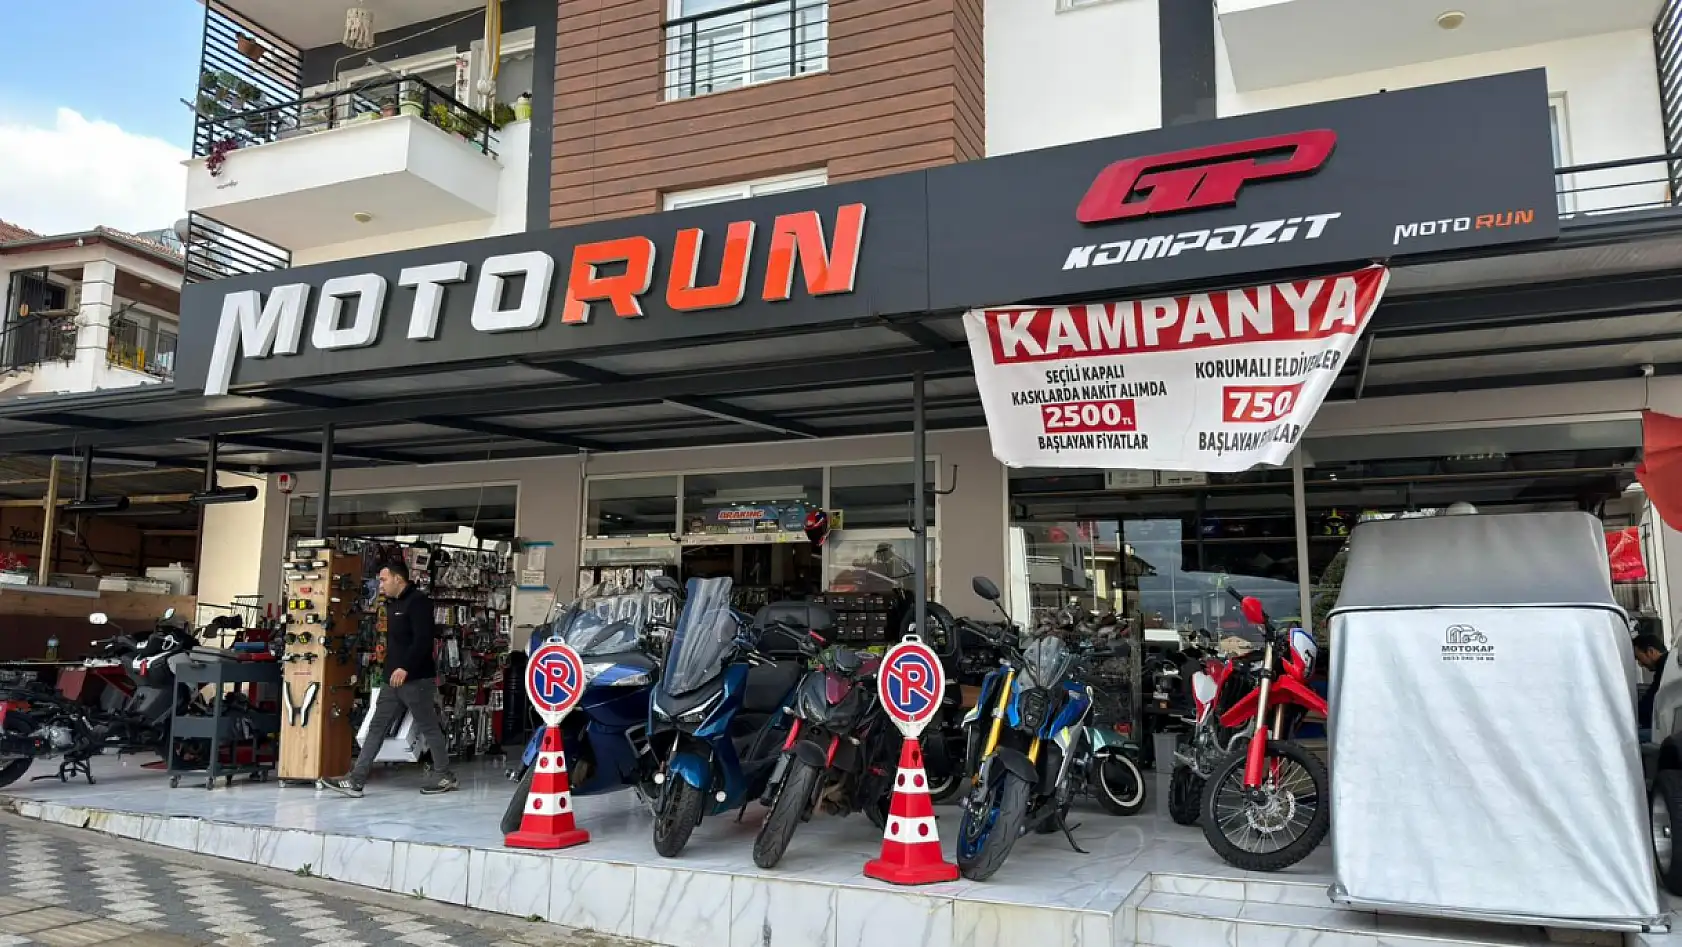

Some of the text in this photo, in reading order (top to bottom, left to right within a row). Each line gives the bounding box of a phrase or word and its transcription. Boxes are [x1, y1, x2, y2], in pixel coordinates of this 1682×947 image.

[996, 276, 1358, 358] KAMPANYA
[1045, 363, 1125, 386] SEÇİLİ KAPALI
[1195, 358, 1271, 379] KORUMALI
[1011, 381, 1168, 406] KASKLARDA NAKİT ALIMDA
[1037, 434, 1095, 453] BAŞLAYAN
[1198, 432, 1261, 456] BAŞLAYAN
[1441, 645, 1495, 653] MOTOKAP
